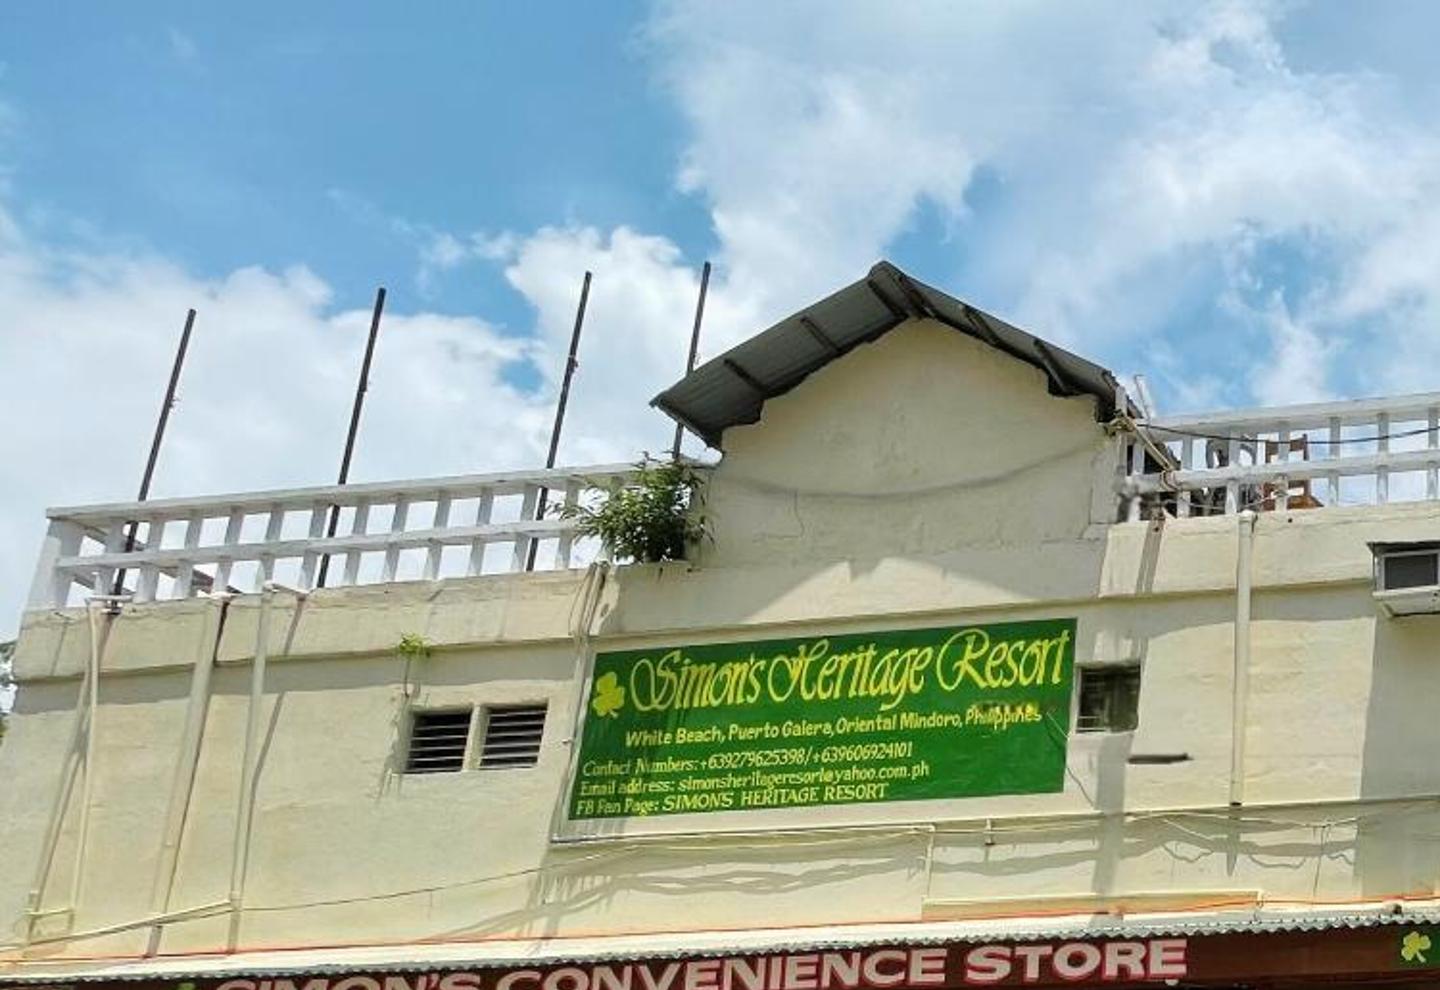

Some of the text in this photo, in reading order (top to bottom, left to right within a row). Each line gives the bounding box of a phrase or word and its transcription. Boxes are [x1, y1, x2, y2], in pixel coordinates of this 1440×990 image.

[629, 629, 1069, 711] Simon's Heritage Resort
[625, 729, 671, 747] White
[676, 726, 726, 745] Beach,
[728, 724, 778, 741] Puerto
[836, 715, 896, 734] Oriental
[900, 711, 962, 731] Mindoro,
[582, 760, 630, 777] Contact
[576, 801, 594, 815] FB
[597, 798, 621, 815] Fan
[624, 796, 659, 816] Page:
[741, 787, 820, 806] HERITAGE
[823, 783, 889, 801] RESORT
[581, 780, 616, 796] Email
[618, 777, 676, 794] address:
[966, 938, 1190, 981] STORE
